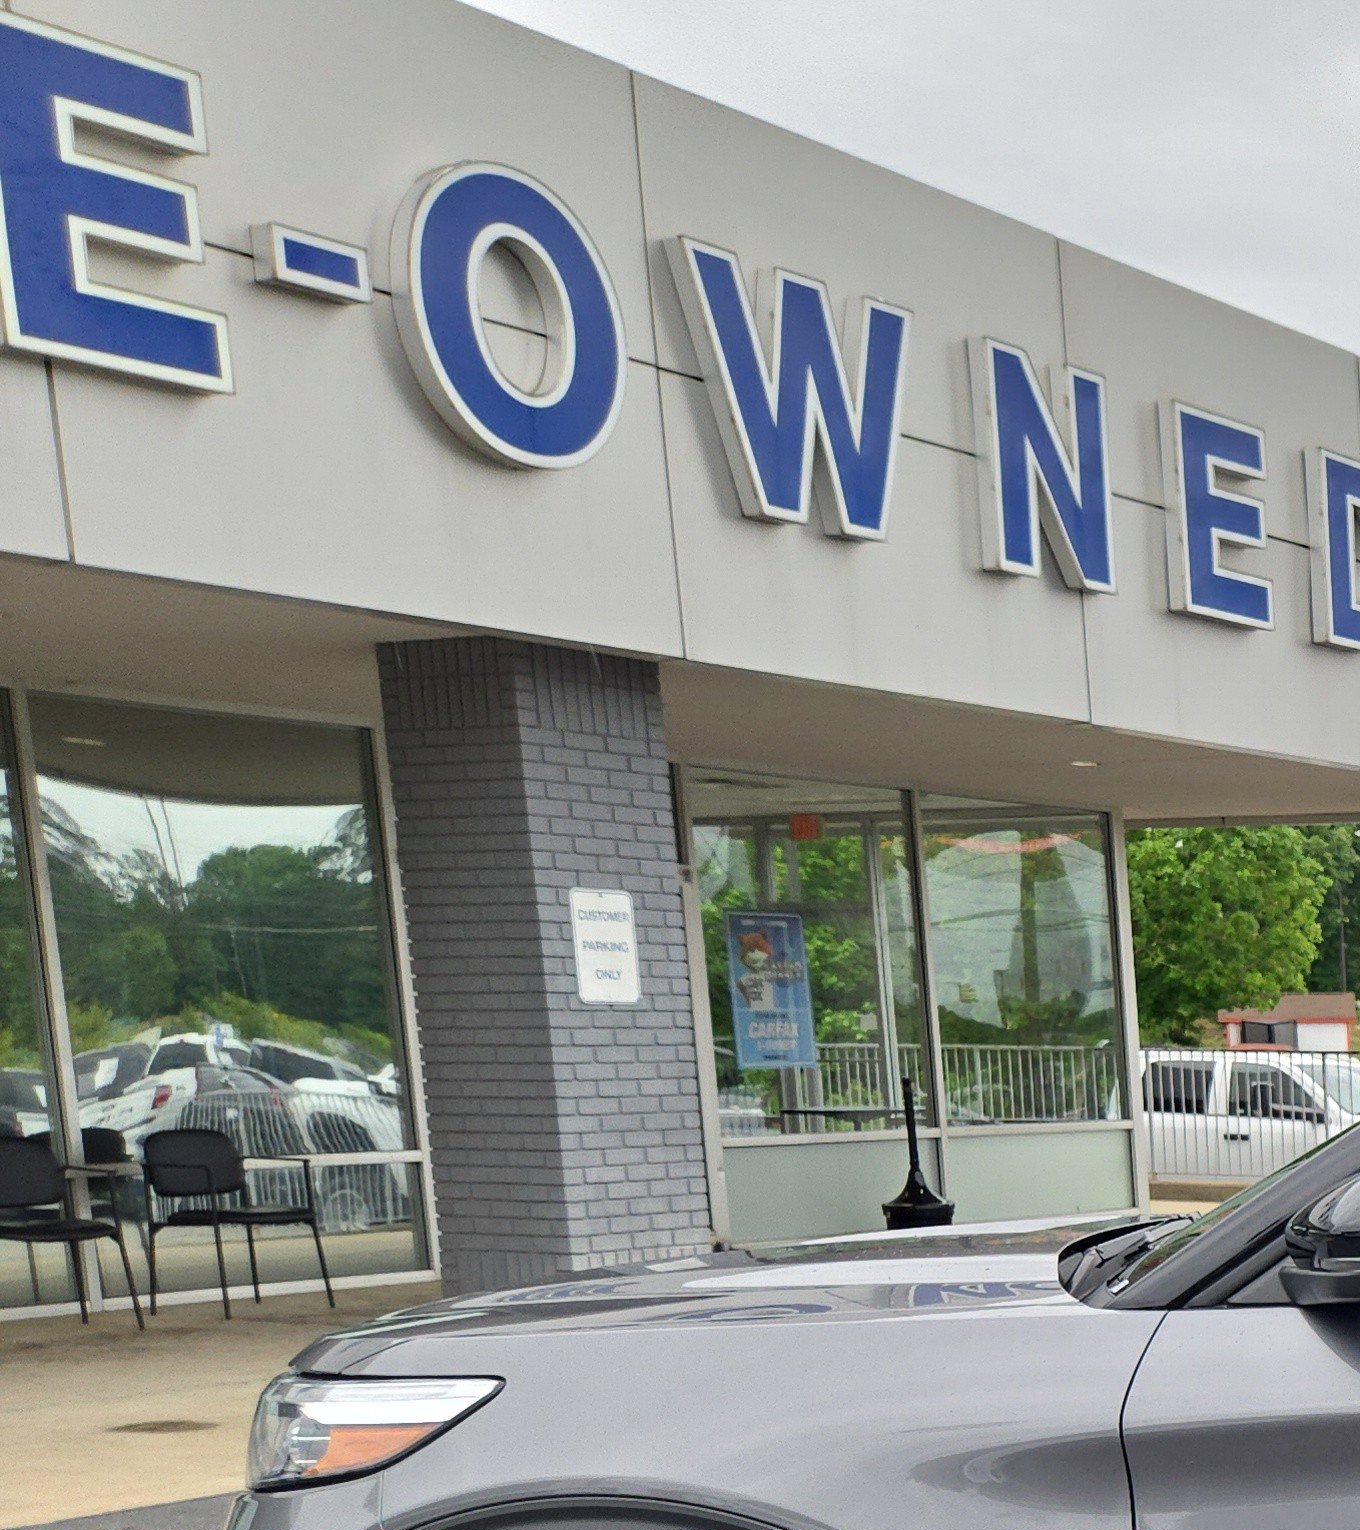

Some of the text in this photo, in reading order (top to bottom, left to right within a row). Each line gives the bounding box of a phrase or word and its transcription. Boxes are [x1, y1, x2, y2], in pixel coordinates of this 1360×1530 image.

[577, 909, 629, 923] CUSTOMER
[581, 940, 629, 953] PARKING
[594, 969, 622, 980] ONLY
